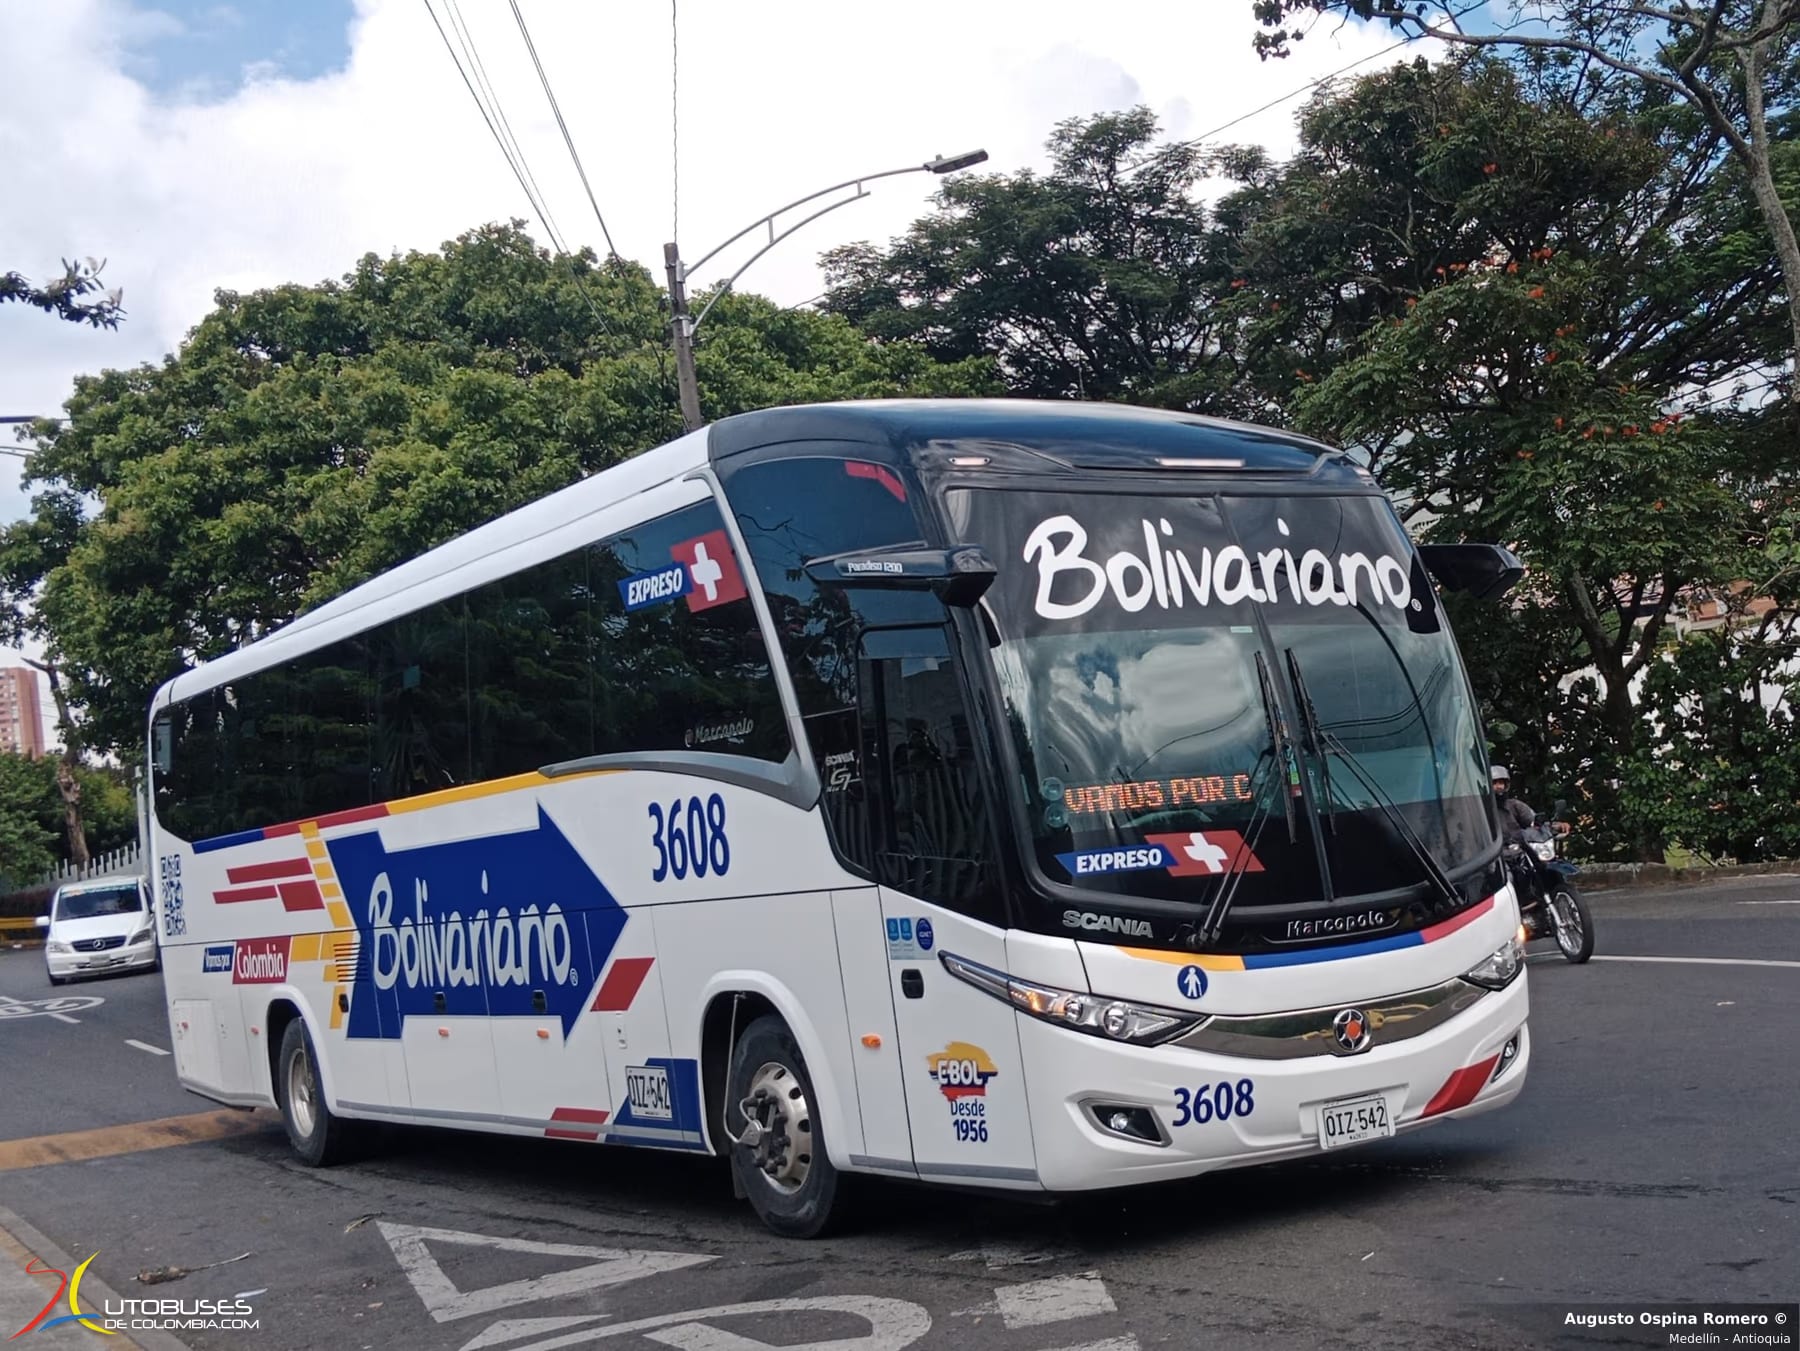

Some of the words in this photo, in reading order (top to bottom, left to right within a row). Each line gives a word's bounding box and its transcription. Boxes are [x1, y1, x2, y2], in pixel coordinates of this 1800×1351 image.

[627, 567, 684, 605] EXPRESO
[1065, 780, 1165, 814] VAMOS
[1169, 775, 1227, 805] POR
[648, 793, 731, 883] 3608
[1076, 848, 1163, 874] EXPRESO
[1062, 909, 1154, 939] SCANIA
[1287, 910, 1384, 938] Marcopolo
[236, 942, 285, 980] Colombia
[950, 1098, 985, 1117] Desde
[1173, 1078, 1255, 1127] 3608
[953, 1119, 988, 1143] 1956
